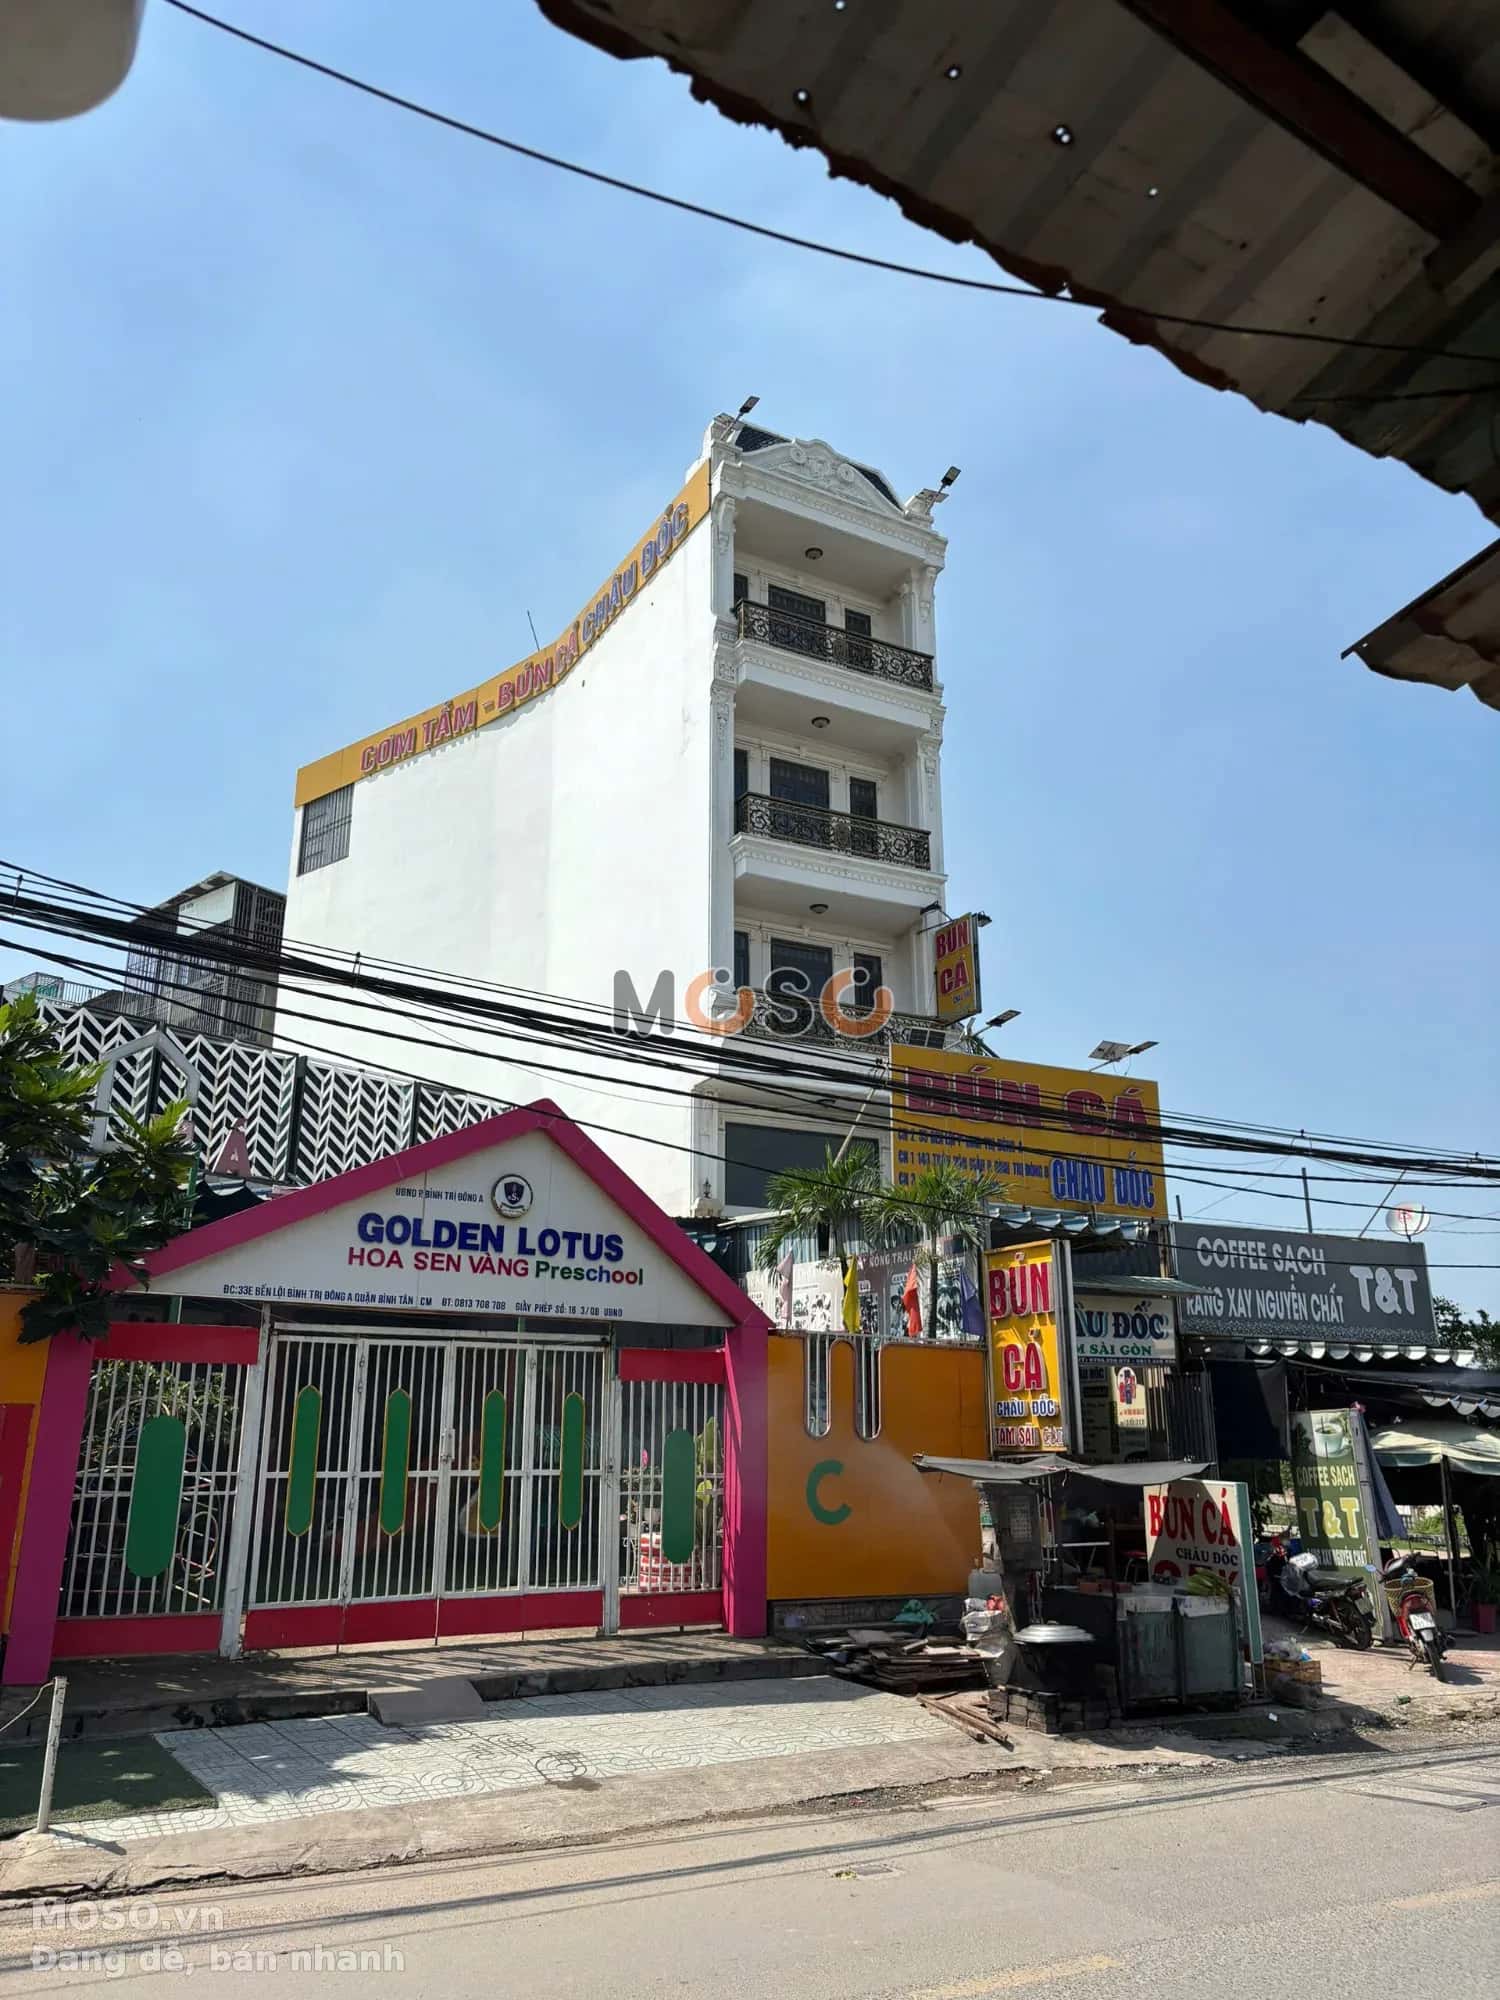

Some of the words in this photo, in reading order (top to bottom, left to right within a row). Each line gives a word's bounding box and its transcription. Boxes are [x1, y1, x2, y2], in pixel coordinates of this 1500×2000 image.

[358, 1212, 505, 1254] GOLDEN
[517, 1227, 624, 1262] LOTUS
[1196, 1236, 1268, 1271] COFFEE
[347, 1246, 403, 1270] HOA
[414, 1251, 462, 1272] SEN
[469, 1251, 529, 1277] VÀNG
[535, 1260, 644, 1285] Preschool
[988, 1252, 1053, 1319] BÚN
[1227, 1287, 1252, 1318] XAY
[1310, 1282, 1345, 1324] CHẤT
[1350, 1265, 1418, 1316] T&T
[1112, 1300, 1168, 1340] ĐỐC
[1003, 1328, 1044, 1391] CÁ
[1089, 1342, 1116, 1356] SÀI
[1119, 1342, 1152, 1356] GÒN
[996, 1396, 1025, 1417] CHÂU
[1031, 1393, 1057, 1417] ĐỐC
[805, 1459, 852, 1525] C
[1296, 1466, 1330, 1487] COFFEE
[1330, 1465, 1356, 1492] SẠCH
[1148, 1485, 1196, 1540] BÚN
[1202, 1487, 1236, 1547] CÁ
[1300, 1497, 1360, 1538] T&T
[1175, 1547, 1210, 1562] CHÂU
[1212, 1546, 1239, 1566] ĐỐC
